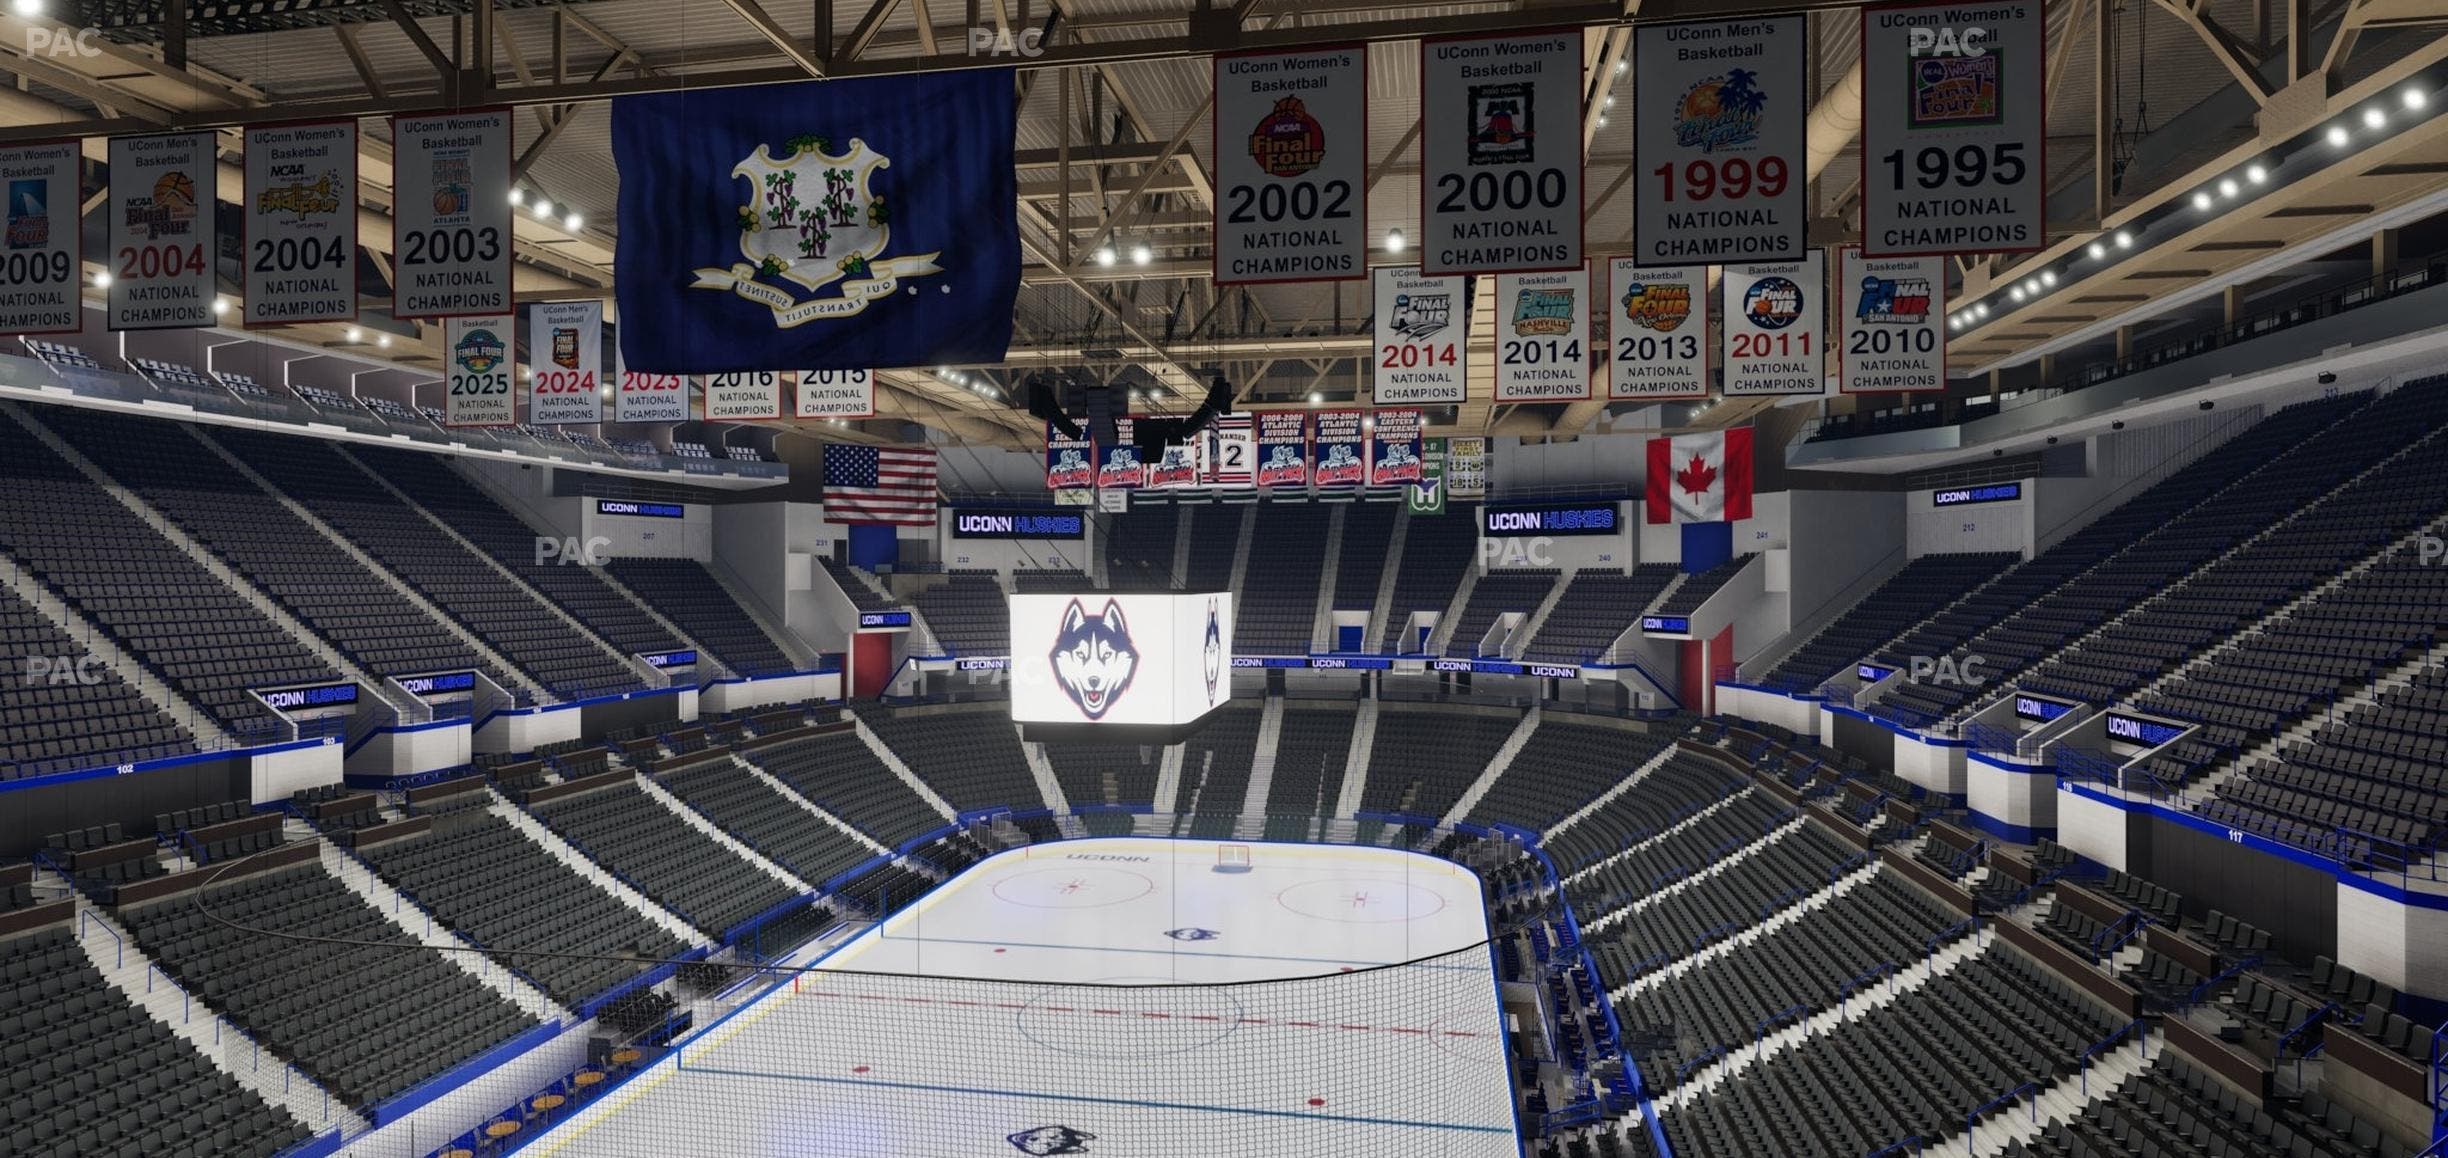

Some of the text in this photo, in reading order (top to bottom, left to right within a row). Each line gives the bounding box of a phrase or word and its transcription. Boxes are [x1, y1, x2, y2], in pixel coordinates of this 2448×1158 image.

[1881, 6, 2025, 28] UConn Women's
[1667, 22, 1775, 42] UConn Men's
[1438, 39, 1566, 60] UConn Women's
[1678, 43, 1763, 61] Basketball
[1229, 55, 1350, 74] UConn Women's
[1461, 61, 1542, 78] Basketball
[1251, 76, 1328, 93] Basketball
[405, 117, 500, 134] UConn Women's
[128, 137, 197, 151] UConn Men's
[254, 130, 345, 144] UConn Women's
[422, 135, 482, 149] Basketball
[24, 148, 71, 161] Women's
[136, 153, 190, 167] Basketball
[271, 146, 329, 160] Basketball
[2, 165, 55, 178] Basketball
[270, 164, 305, 177] NCAA
[1883, 142, 2026, 191] 1995
[1654, 155, 1788, 202] 1999
[1436, 168, 1567, 214] 2000
[1228, 179, 1351, 223] 2002
[1898, 198, 2015, 219] NATIONAL
[1667, 209, 1779, 230] NATIONAL
[1453, 220, 1558, 239] NATIONAL
[1884, 224, 2027, 246] CHAMPIONS
[404, 226, 500, 265] 2003
[1244, 230, 1342, 249] NATIONAL
[1655, 235, 1790, 256] CHAMPIONS
[254, 235, 346, 272] 2004
[1441, 245, 1568, 266] CHAMPIONS
[119, 244, 206, 279] 2004
[1232, 254, 1352, 275] CHAMPIONS
[1866, 261, 1919, 271] Basketball
[1633, 271, 1683, 281] Basketball
[1748, 264, 1800, 275] Basketball
[416, 270, 493, 287] NATIONAL
[1397, 280, 1444, 290] Basketball
[1518, 275, 1567, 286] Basketball
[129, 286, 199, 301] NATIONAL
[266, 279, 339, 295] NATIONAL
[1647, 285, 1690, 300] FINAL
[1761, 287, 1796, 300] FINAL
[257, 300, 346, 316] CHAMPIONS
[407, 293, 501, 310] CHAMPIONS
[1408, 297, 1449, 310] FINAL
[1628, 296, 1691, 317] FOUR
[121, 306, 206, 323] CHAMPIONS
[543, 306, 567, 314] UConn
[1391, 306, 1449, 328] FOUR
[462, 319, 498, 328] Basketball
[548, 315, 584, 325] Basketball
[1618, 335, 1698, 361] 2013
[1732, 332, 1810, 358] 2011
[1850, 328, 1935, 354] 2010
[1382, 343, 1457, 368] 2014
[1504, 339, 1581, 365] 2014
[1628, 365, 1692, 377] NATIONAL
[1742, 362, 1808, 374] NATIONAL
[1861, 359, 1929, 371] NATIONAL
[536, 371, 595, 393] 2024
[622, 370, 680, 392] 2023
[712, 370, 773, 388] 2016
[803, 368, 866, 385] 2015
[1391, 373, 1452, 383] NATIONAL
[1513, 370, 1576, 381] NATIONAL
[1853, 375, 1936, 387] CHAMPIONS
[451, 373, 508, 396] 2025
[1506, 384, 1582, 395] CHAMPIONS
[1621, 381, 1698, 393] CHAMPIONS
[1735, 378, 1815, 390] CHAMPIONS
[719, 391, 769, 401] NATIONAL
[810, 389, 862, 399] NATIONAL
[1384, 388, 1458, 399] CHAMPIONS
[459, 399, 504, 409] NATIONAL
[542, 397, 589, 407] NATIONAL
[627, 396, 677, 406] NATIONAL
[538, 410, 594, 420] CHAMPIONS
[623, 409, 681, 419] CHAMPIONS
[713, 405, 774, 416] CHAMPIONS
[804, 403, 867, 414] CHAMPIONS
[453, 412, 509, 422] CHAMPIONS
[1319, 420, 1359, 428] ATLANTIC
[1261, 421, 1302, 429] ATLANTIC
[1321, 428, 1357, 436] DIVISION
[1374, 425, 1420, 433] CONFERENCE
[1258, 436, 1305, 444] CHAMPIONS
[1264, 429, 1299, 437] DIVISION
[1316, 435, 1362, 443] CHAMPIONS
[1376, 432, 1419, 440] CHAMPIONS
[1048, 441, 1090, 449] CHAMPIONS
[1937, 490, 1970, 503] UCONN
[601, 502, 638, 514] UCONN
[959, 515, 1080, 534] UCONN HUSKIES
[1489, 509, 1614, 531] UCONN HUSKIES
[862, 615, 884, 625] UCONN
[1643, 618, 1662, 629] UCONN
[961, 660, 1004, 670] UCONN
[1231, 658, 1345, 669] UCONN UCONN
[1434, 661, 1575, 678] UCONN UCONN
[1858, 665, 1874, 679] UCONN
[2017, 697, 2041, 717] UCONN
[2108, 716, 2141, 738] UCONN
[117, 763, 133, 775] 102
[2229, 829, 2243, 844] 117
[1067, 853, 1150, 863] UCONN
